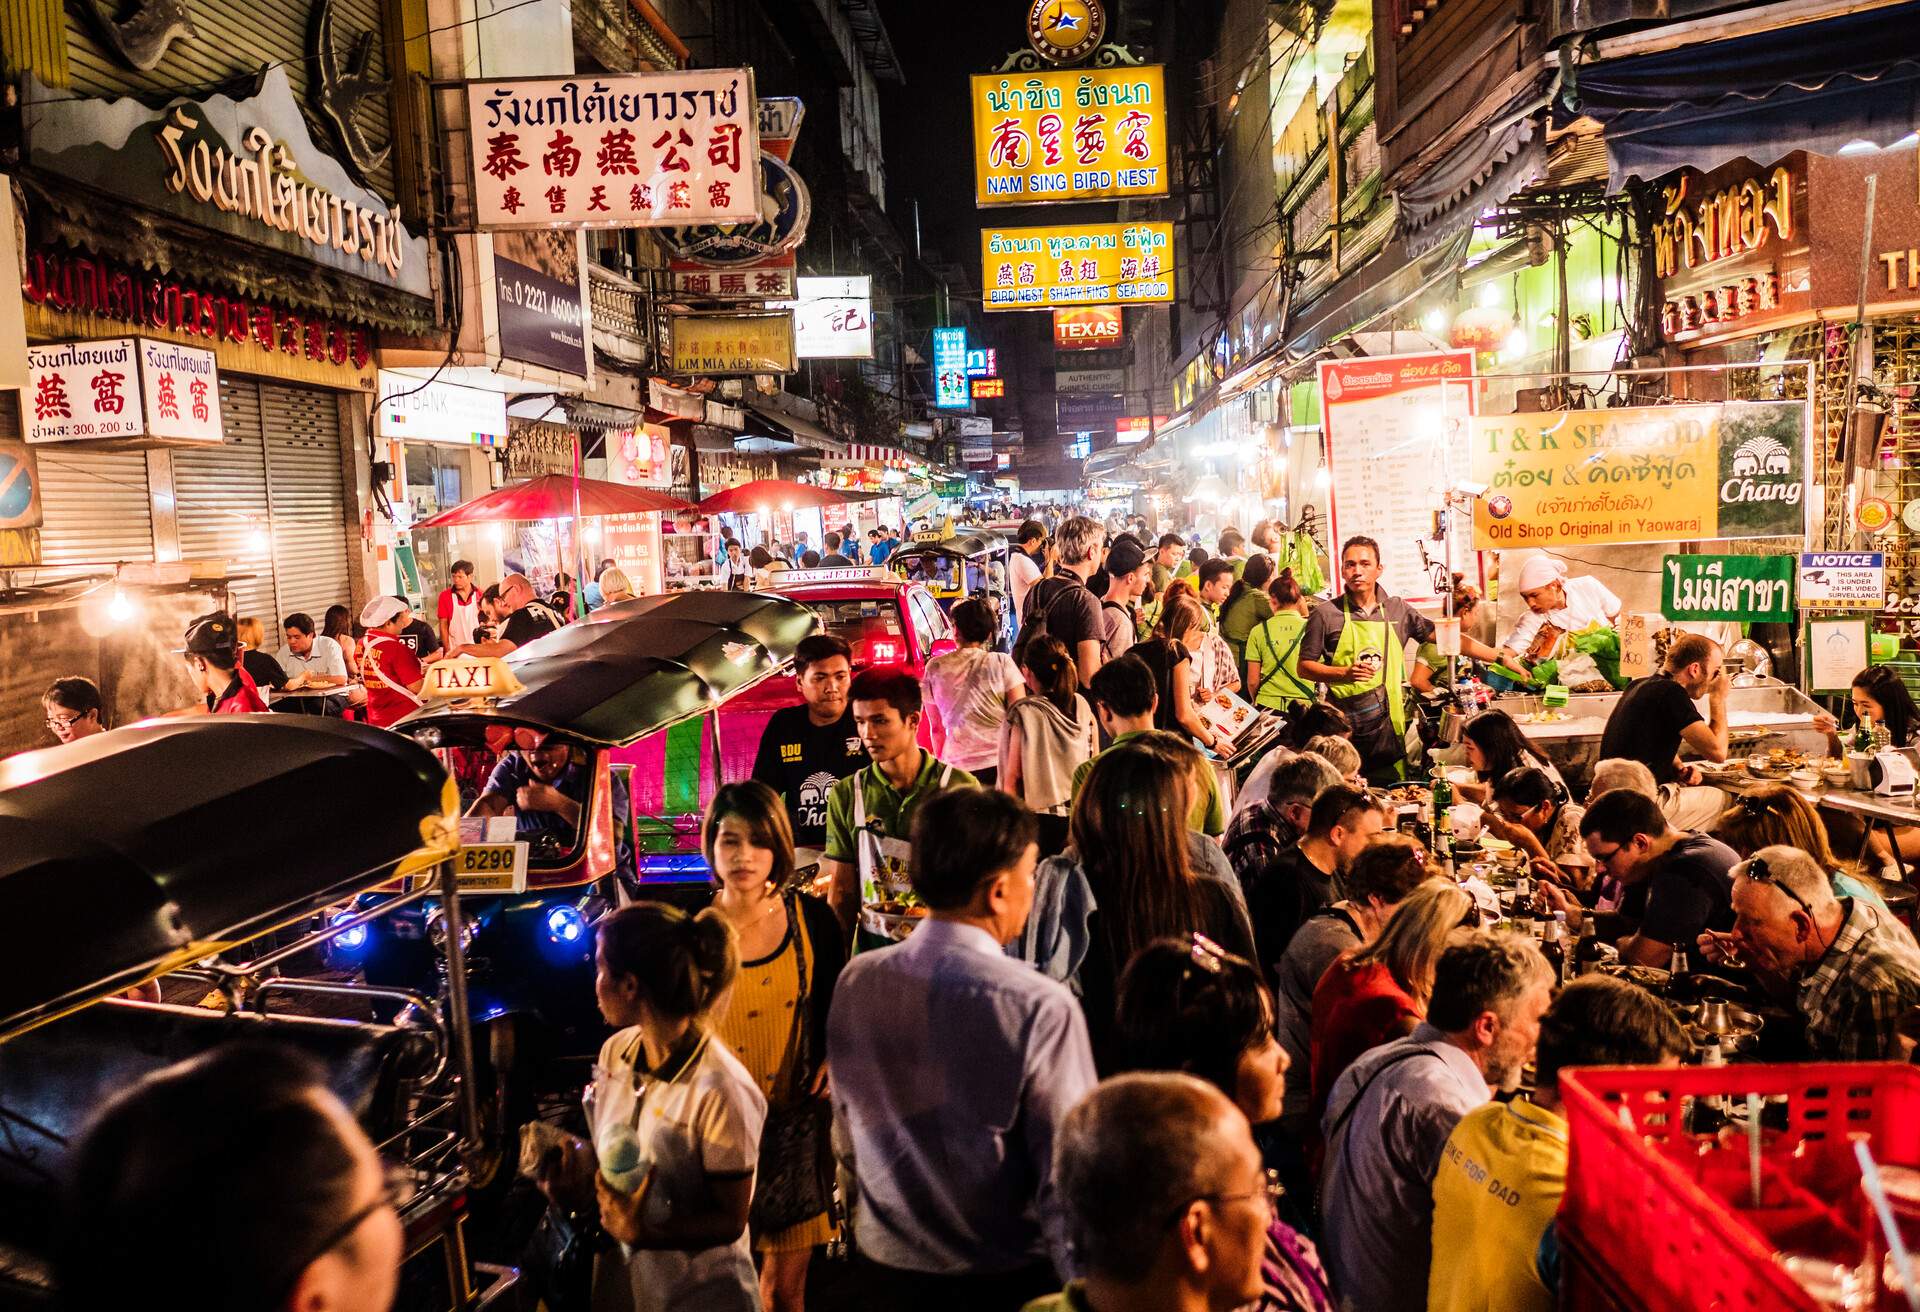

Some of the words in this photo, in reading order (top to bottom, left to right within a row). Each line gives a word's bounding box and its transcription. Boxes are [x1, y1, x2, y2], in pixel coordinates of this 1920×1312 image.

[485, 79, 739, 128] รังนกใต้เยาวราช
[1076, 77, 1150, 106] รังนก
[482, 124, 743, 181] 泰南燕公司
[158, 107, 404, 279] รังนกใต้เยาวราช
[988, 176, 1023, 194] NAM
[1030, 174, 1066, 192] SING
[1074, 171, 1110, 189] BIRD
[1118, 169, 1157, 186] NEST
[990, 235, 1042, 253] รังนก
[1047, 234, 1116, 257] หูฉลาม
[997, 263, 1035, 285] 燕窩
[1059, 259, 1098, 282] 魚翅
[1121, 257, 1160, 279] 海鮮
[515, 280, 523, 306] 0
[525, 284, 548, 315] 2221
[551, 295, 581, 328] 4600-2
[991, 289, 1015, 302] BIRD
[1018, 288, 1043, 301] NEST
[1050, 287, 1083, 300] SHARK
[1086, 286, 1109, 298] FINS
[1117, 284, 1137, 297] SEA
[1139, 283, 1168, 297] FOOD
[1057, 322, 1119, 337] TEXAS
[678, 358, 699, 369] LIM
[703, 358, 725, 369] MIA
[729, 357, 754, 369] KEE
[1068, 373, 1112, 382] AUTHENTIC
[35, 369, 126, 421] 燕窩
[157, 371, 209, 423] 燕窩
[413, 390, 449, 414] BANK
[1484, 428, 1503, 453] T
[1511, 428, 1530, 451] &
[1540, 425, 1559, 450] K
[1562, 463, 1581, 486] &
[1489, 524, 1512, 539] Old
[1518, 523, 1553, 540] Shop
[1560, 521, 1613, 539] Original
[1619, 521, 1631, 533] in
[1637, 516, 1702, 534] Yaowaraj
[1812, 555, 1873, 567] NOTICE
[786, 572, 816, 581] TAXI
[823, 569, 872, 579] METER
[1667, 560, 1789, 613] ไม่มีสาขา
[434, 666, 492, 688] TAXI
[465, 849, 513, 869] 6290
[1488, 1178, 1521, 1207] DAD
